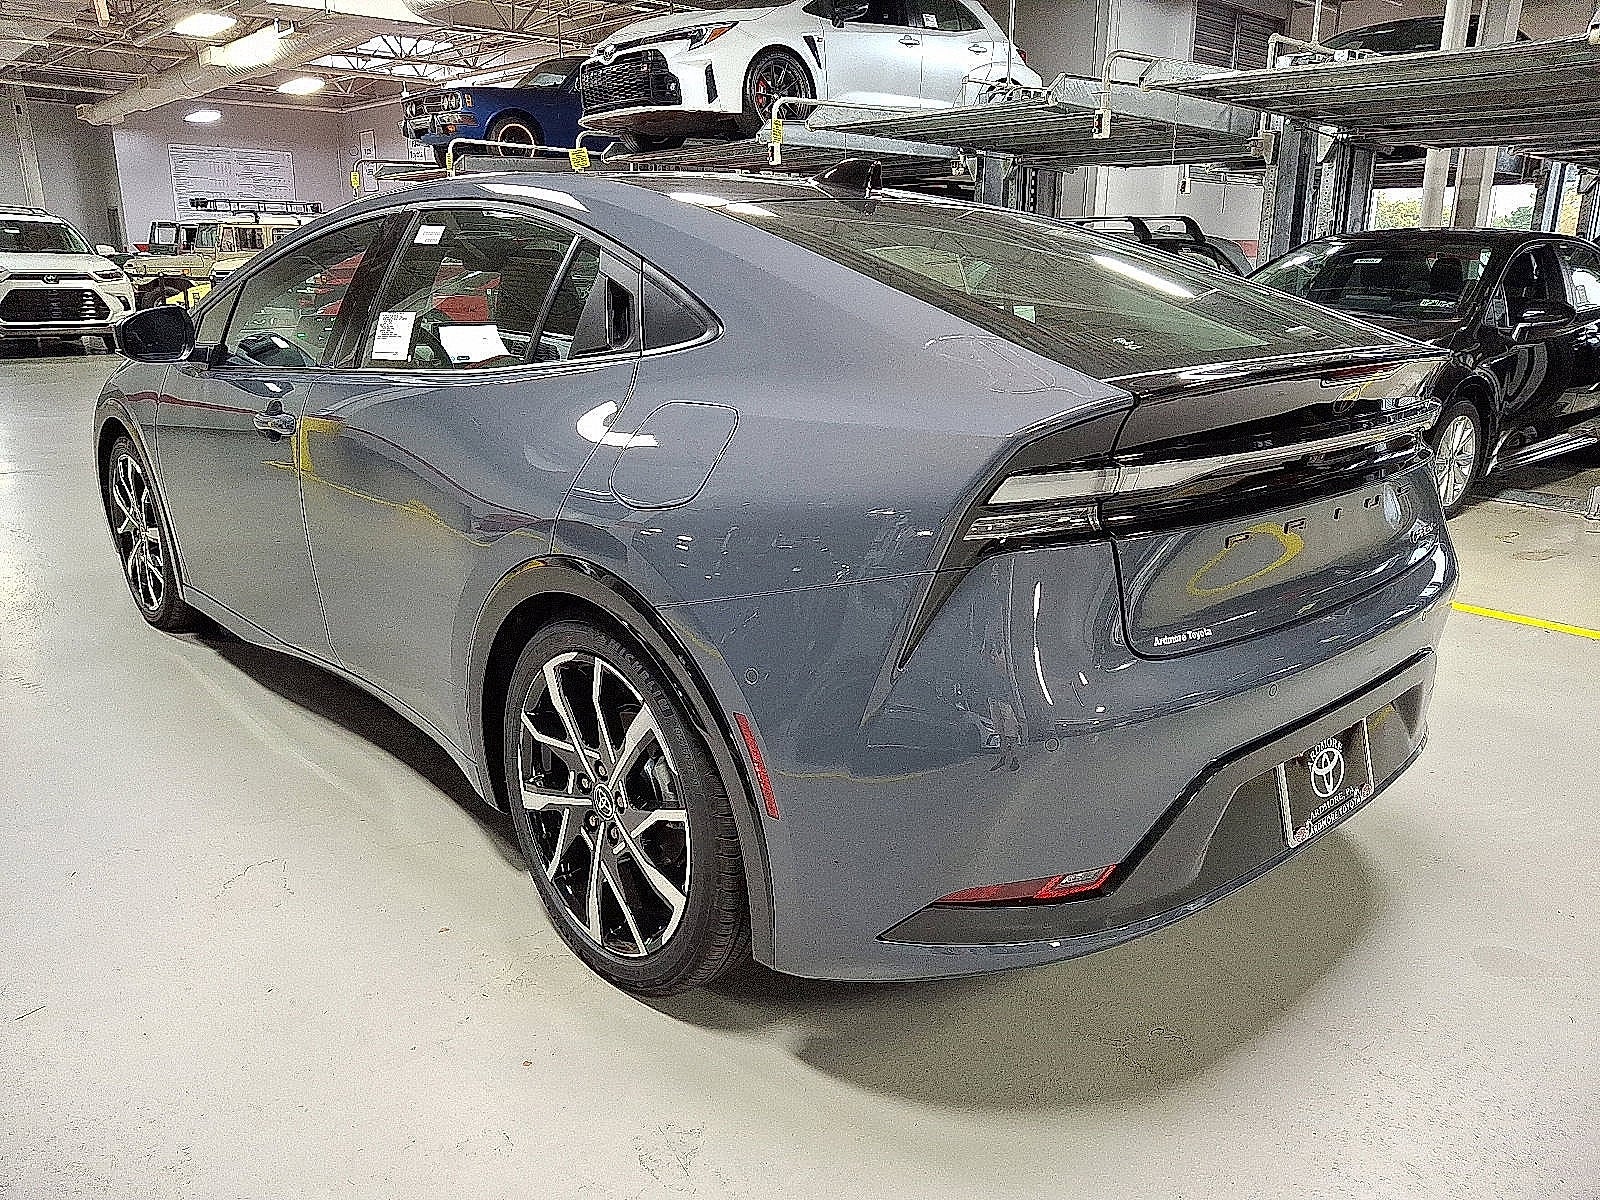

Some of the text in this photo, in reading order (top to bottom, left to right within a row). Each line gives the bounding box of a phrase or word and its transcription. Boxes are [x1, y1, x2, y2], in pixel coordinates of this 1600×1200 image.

[1153, 627, 1213, 647] Ardmore Toyota
[608, 639, 672, 713] MICHELIN
[1310, 791, 1345, 820] ARDMORE,
[1309, 811, 1338, 837] ARDMORE
